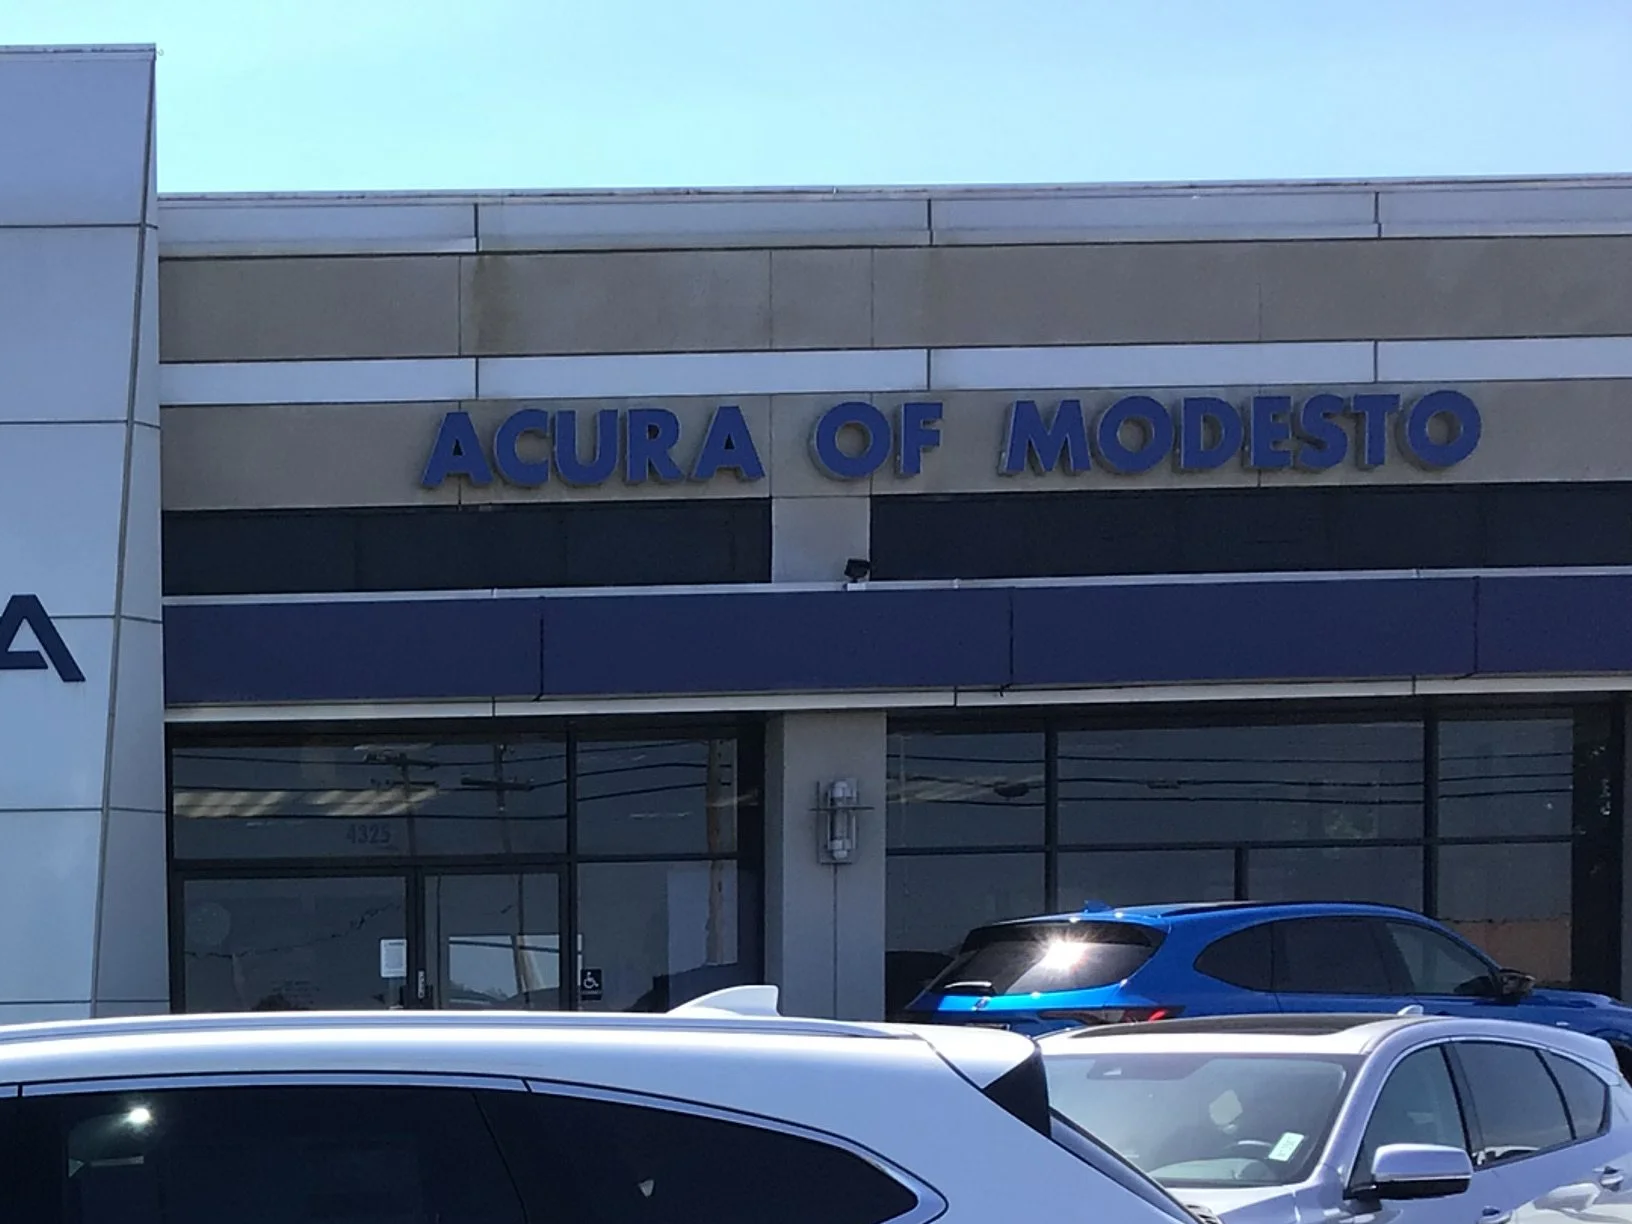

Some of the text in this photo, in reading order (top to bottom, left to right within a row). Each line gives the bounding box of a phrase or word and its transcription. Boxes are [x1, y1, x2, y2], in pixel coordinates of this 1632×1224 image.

[421, 390, 1482, 488] ACURA OF MODESTO
[346, 822, 391, 844] 4325
